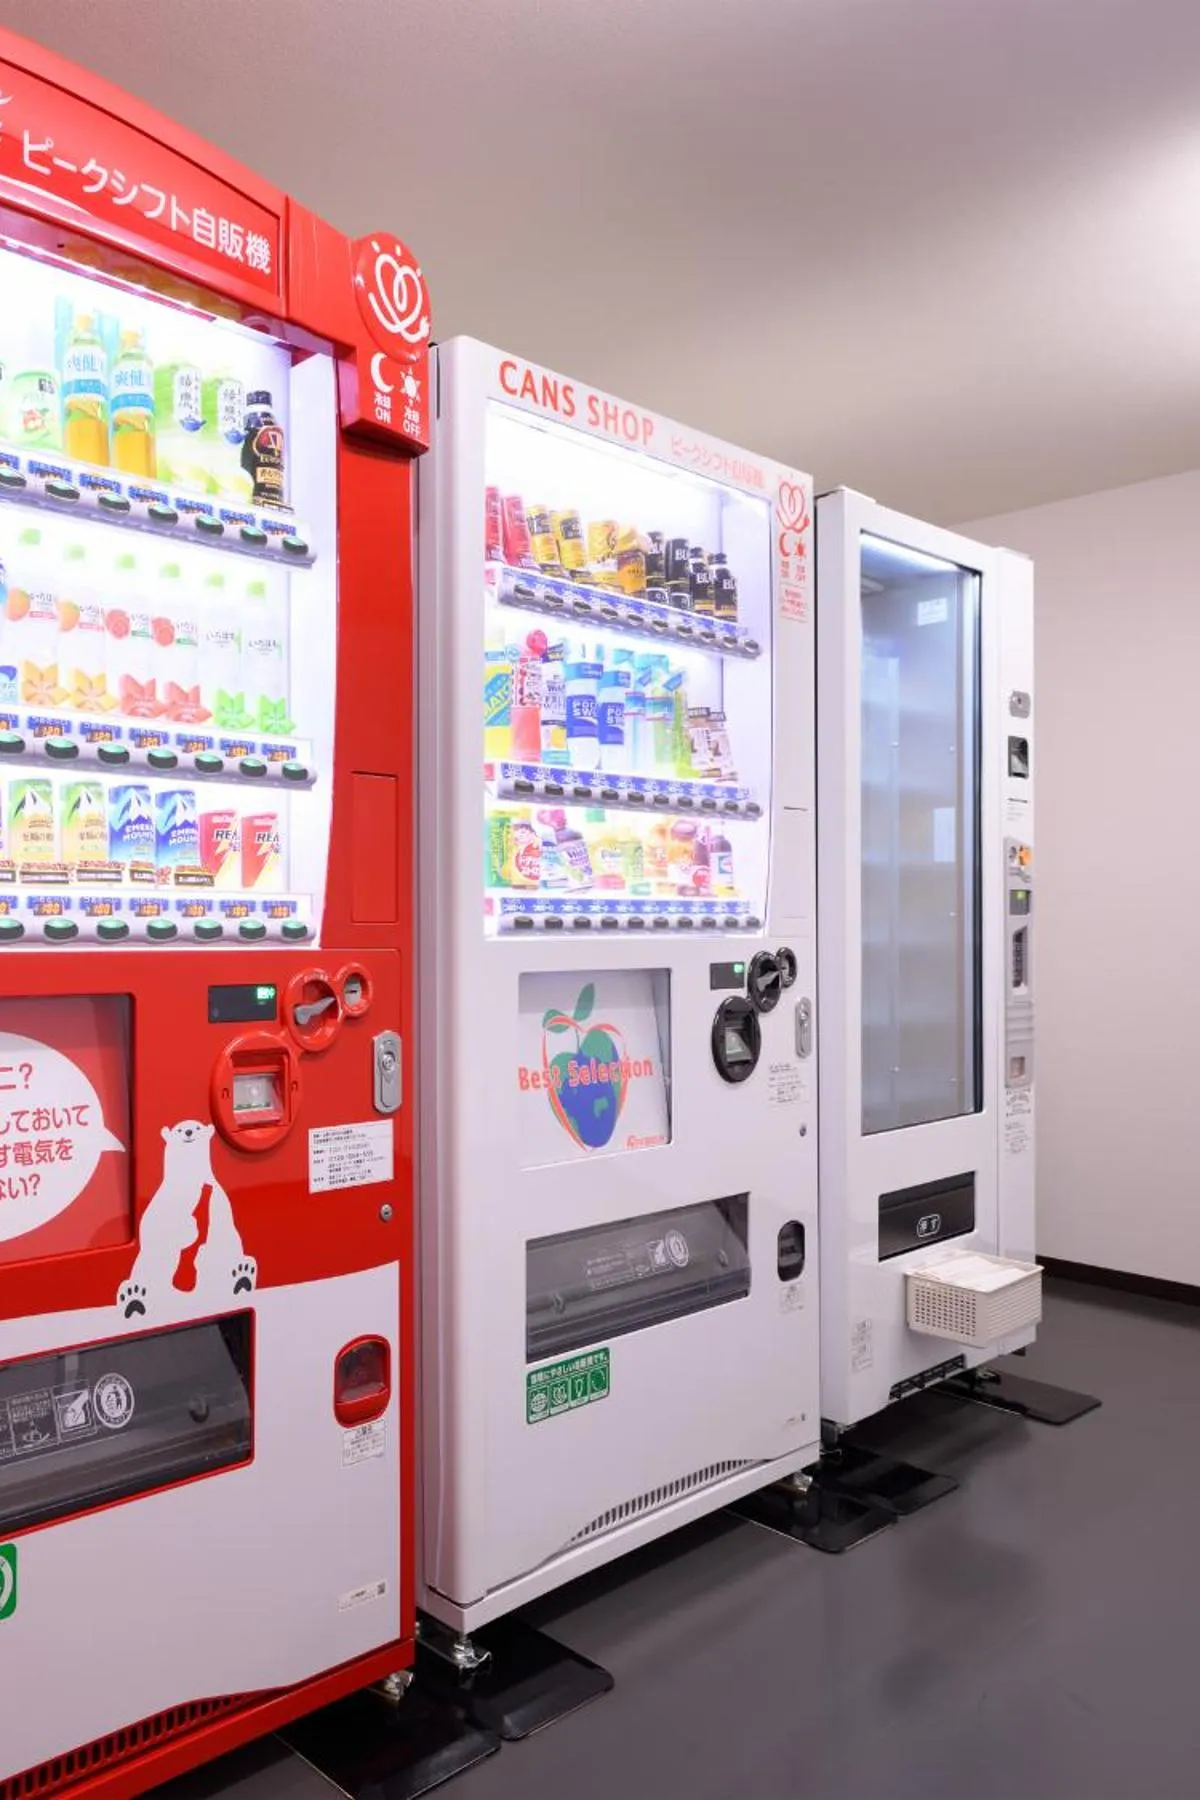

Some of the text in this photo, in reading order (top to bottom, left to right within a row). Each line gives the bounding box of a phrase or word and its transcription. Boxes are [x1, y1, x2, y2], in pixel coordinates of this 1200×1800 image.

[21, 129, 272, 275] ピークシフト自販機
[499, 360, 655, 446] CANS SHOP
[518, 1056, 653, 1091] Best Selection
